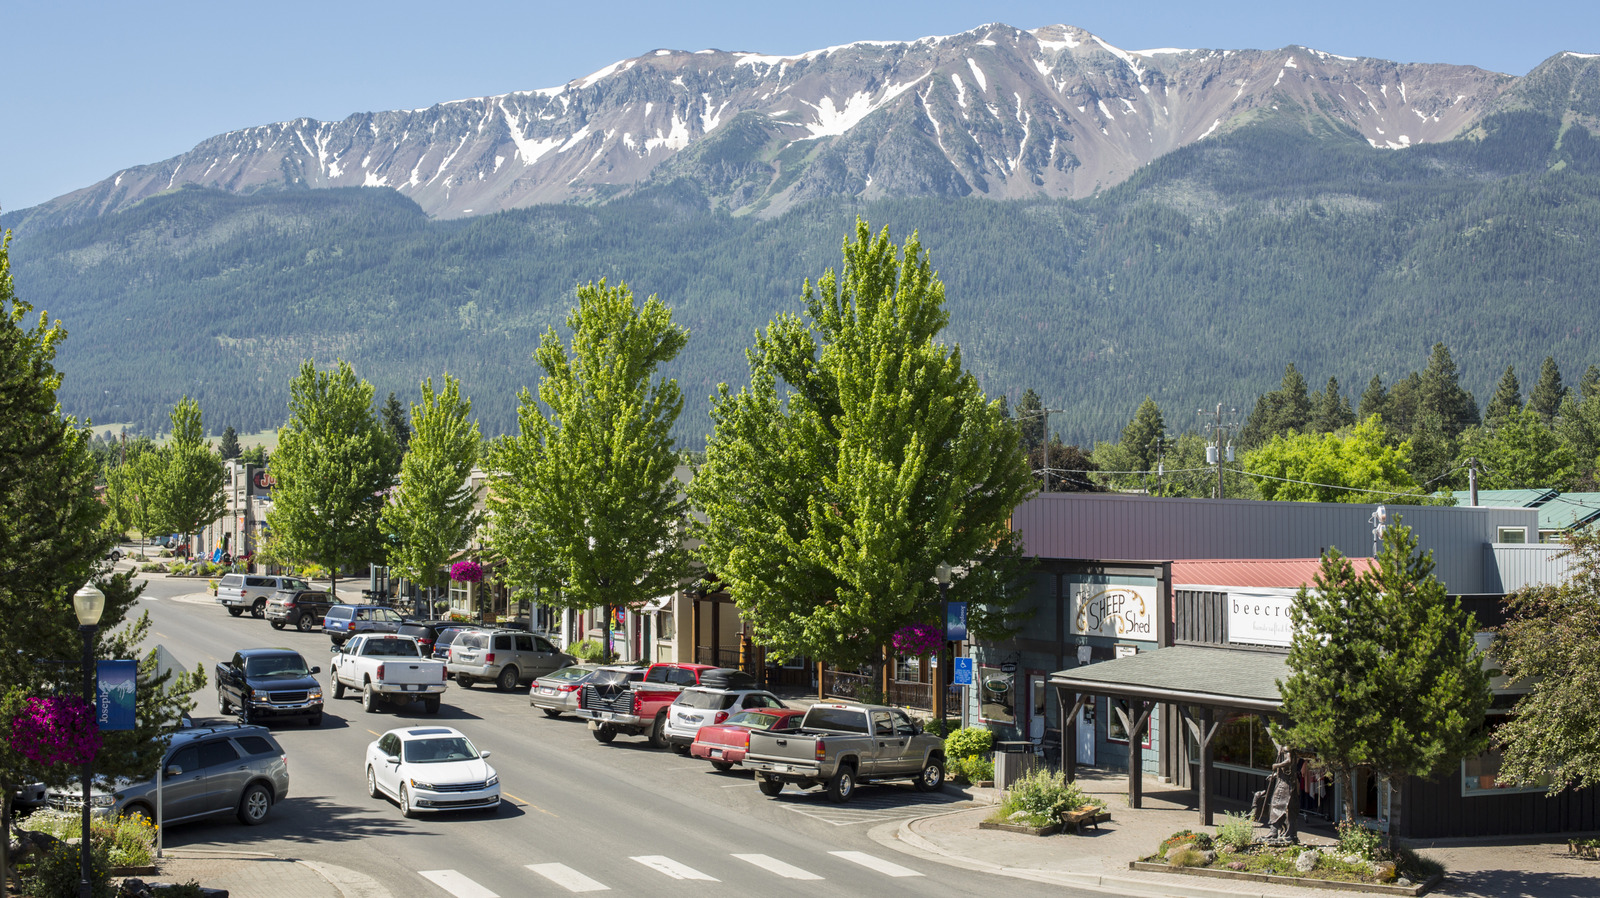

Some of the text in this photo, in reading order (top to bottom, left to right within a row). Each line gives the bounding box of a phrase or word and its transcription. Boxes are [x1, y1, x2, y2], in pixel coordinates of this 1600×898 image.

[1088, 594, 1126, 632] SHEEP
[1125, 610, 1150, 634] Shed
[1233, 599, 1291, 618] beecro
[99, 690, 111, 724] Joseph
